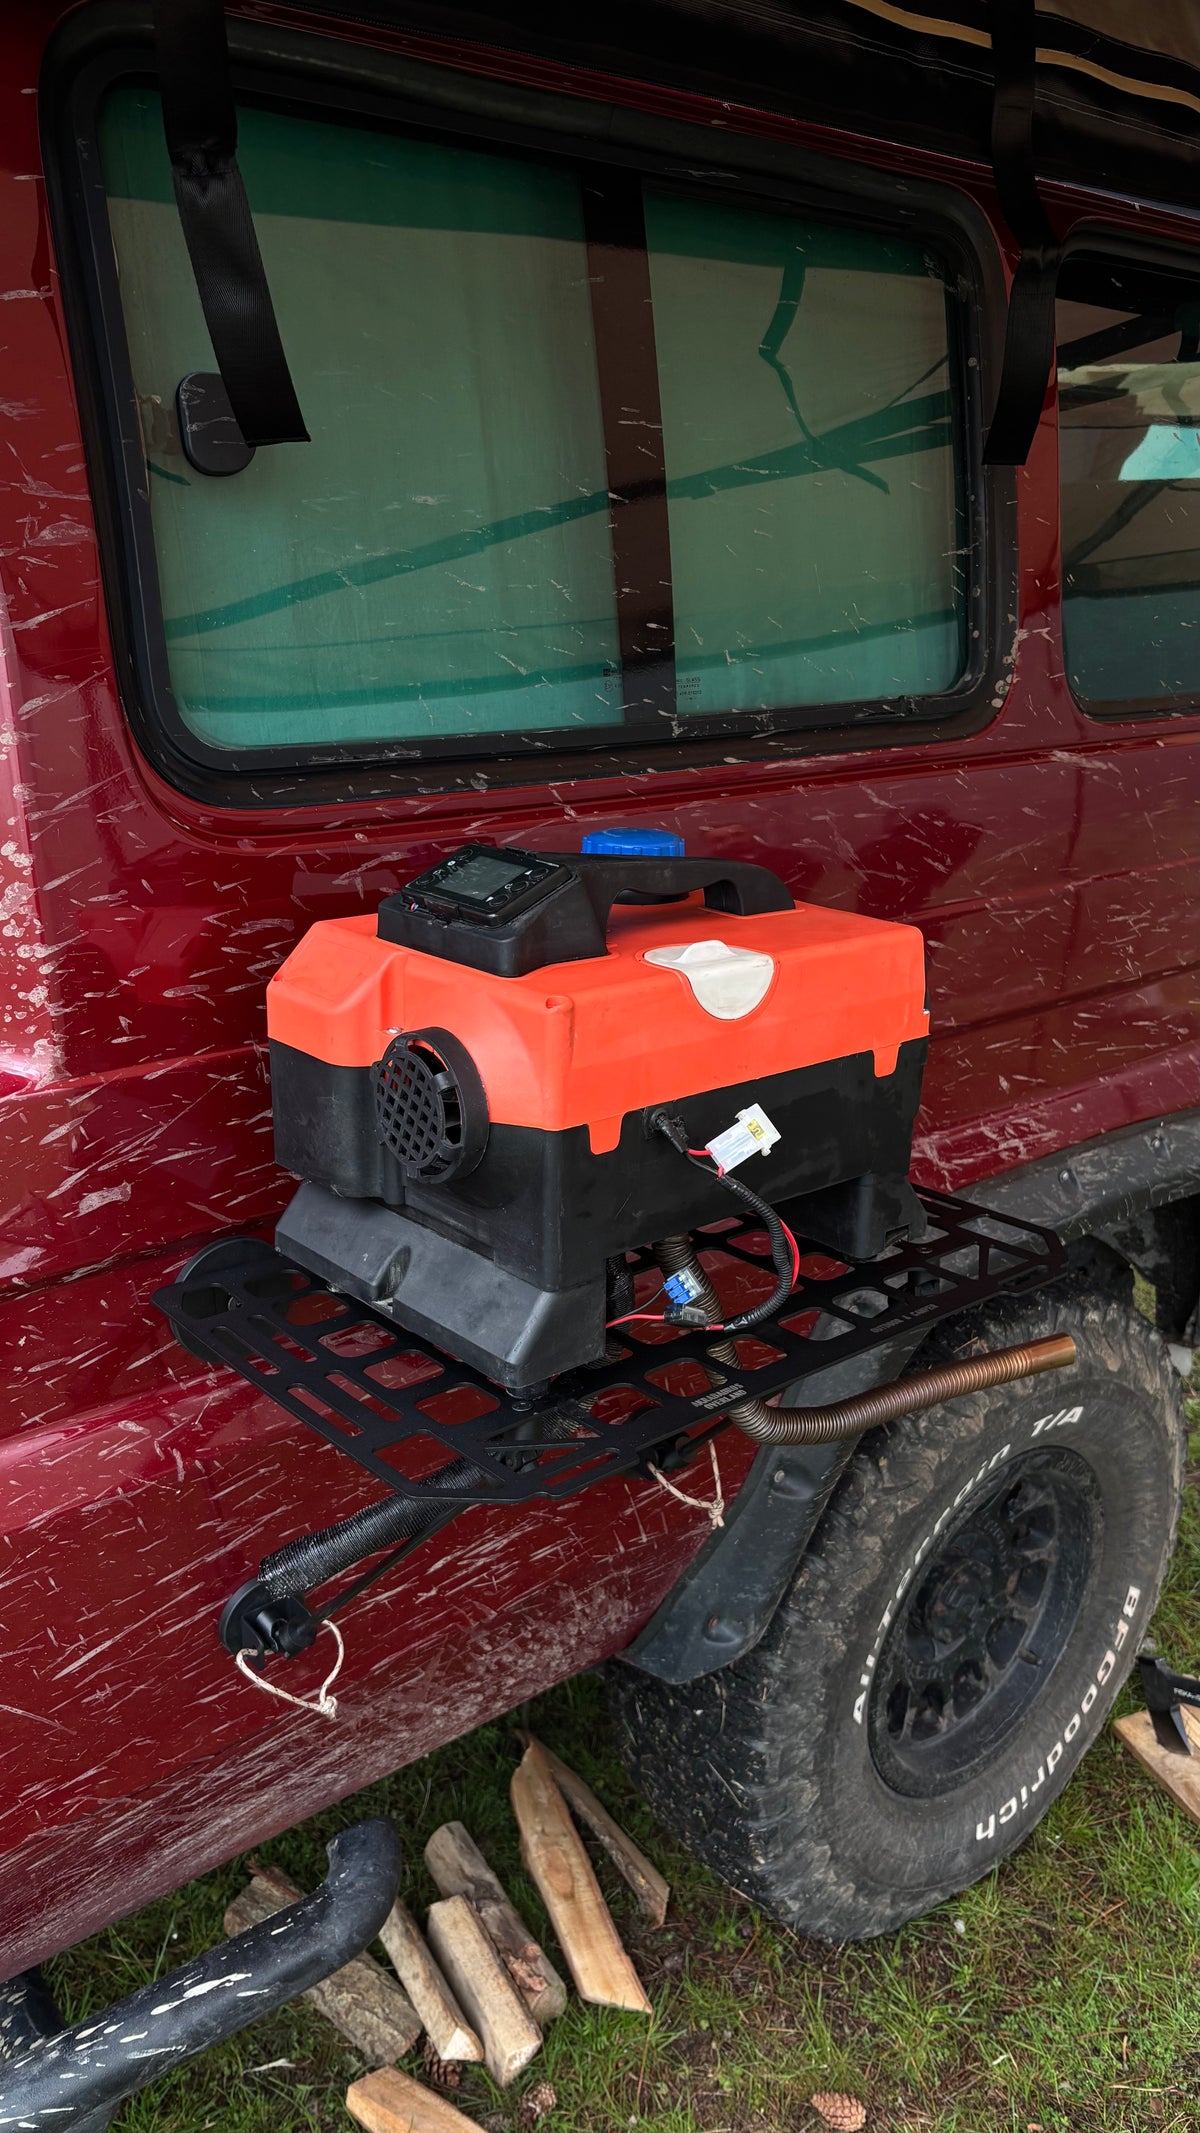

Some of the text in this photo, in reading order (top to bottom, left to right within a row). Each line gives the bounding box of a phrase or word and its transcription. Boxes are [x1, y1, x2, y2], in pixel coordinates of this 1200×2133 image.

[703, 1389, 748, 1410] OVERLAND
[852, 1405, 1084, 1725] All-Terrain T/A
[975, 1584, 1141, 1841] BFGoodrich
